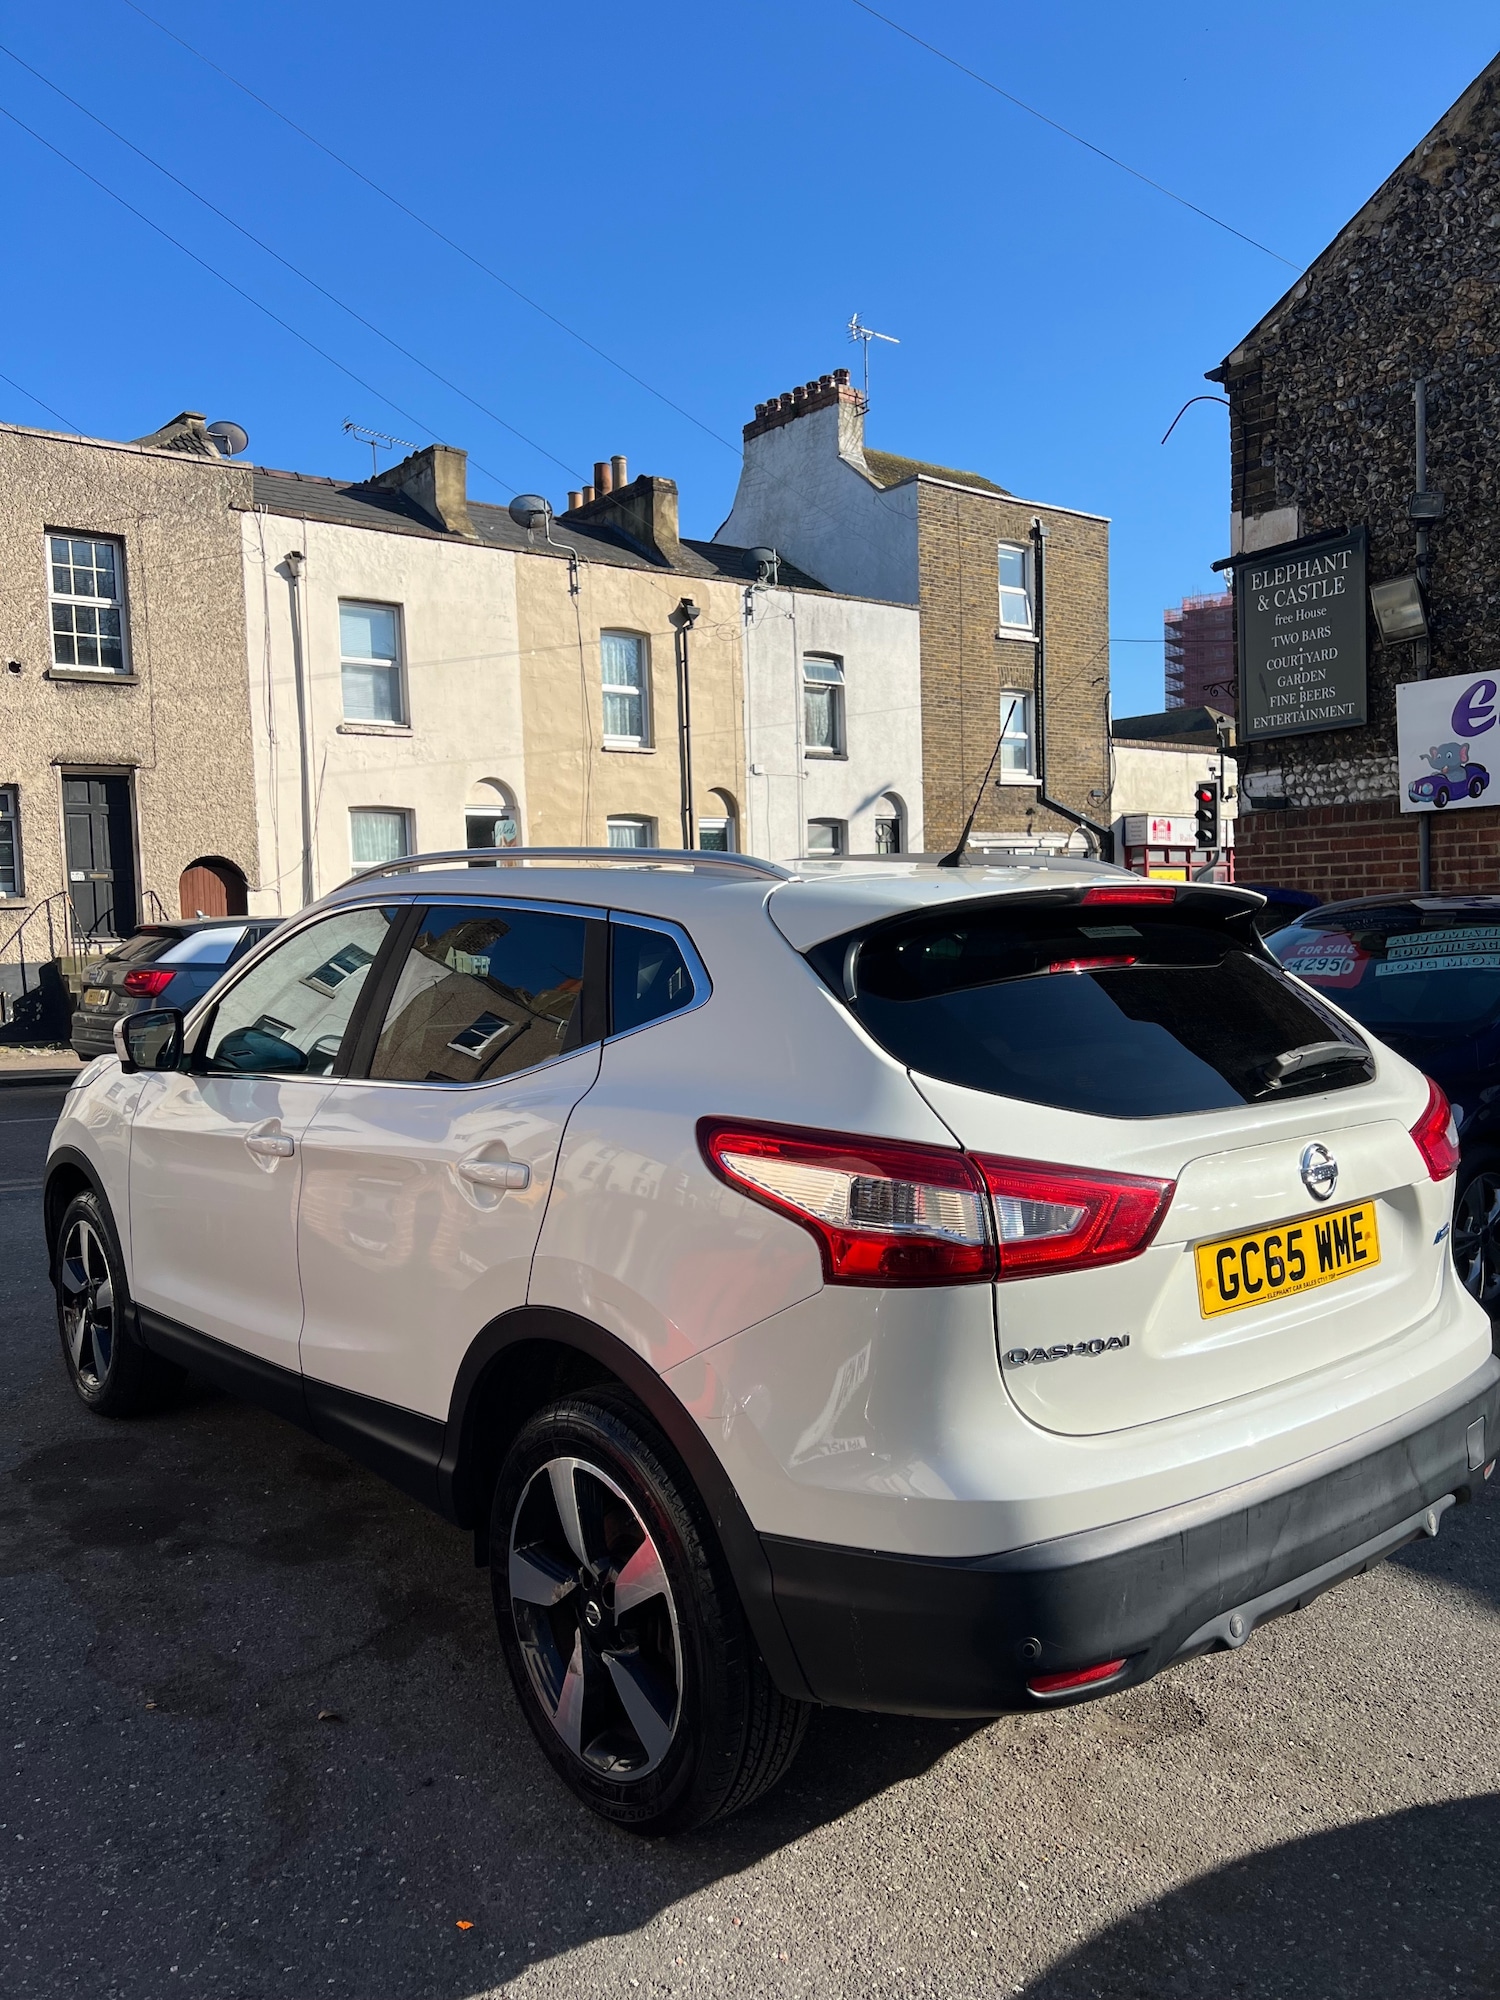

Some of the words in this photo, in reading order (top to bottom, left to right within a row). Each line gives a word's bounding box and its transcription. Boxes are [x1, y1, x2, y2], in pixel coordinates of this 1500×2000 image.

[1251, 550, 1352, 591] ELEPHANT
[1257, 595, 1270, 612] &
[1274, 576, 1346, 608] CASTLE
[1275, 613, 1293, 626] free
[1295, 607, 1327, 621] House
[1271, 632, 1299, 648] TWO
[1301, 625, 1332, 642] BARS
[1266, 647, 1338, 671] COURTYARD
[1277, 668, 1327, 688] GARDEN
[1269, 692, 1297, 708] FINE
[1299, 686, 1336, 703] BEERS
[1253, 702, 1355, 729] ENTERTAINMENT
[1297, 945, 1324, 955] FOR
[1324, 943, 1356, 954] SALE
[1392, 946, 1430, 957] LOW
[1382, 960, 1437, 974] LONG
[1216, 1229, 1306, 1301] GC65
[1314, 1211, 1368, 1273] WME
[1267, 1287, 1292, 1299] ELEPHANT
[1293, 1284, 1303, 1292] CAR
[1303, 1279, 1317, 1288] SALES
[1008, 1333, 1130, 1364] QASHQAI
